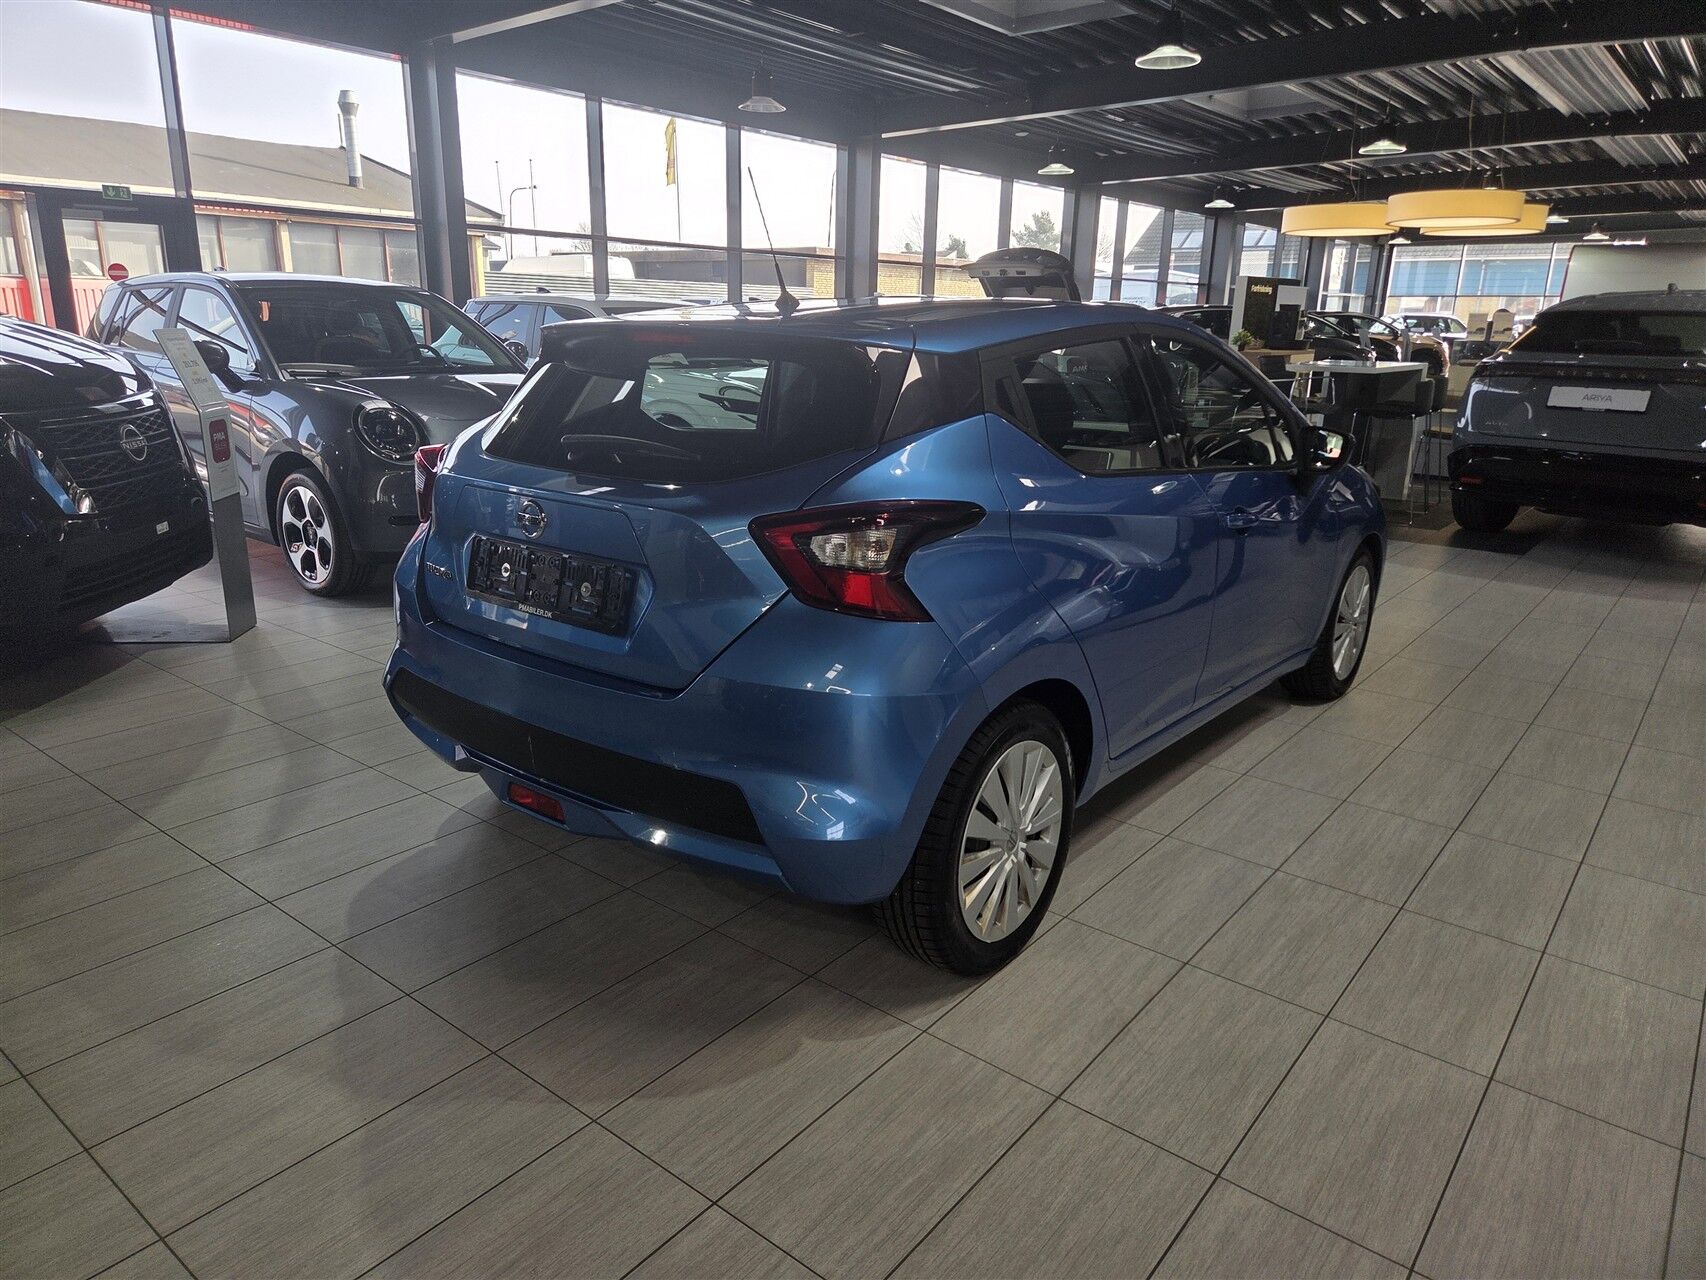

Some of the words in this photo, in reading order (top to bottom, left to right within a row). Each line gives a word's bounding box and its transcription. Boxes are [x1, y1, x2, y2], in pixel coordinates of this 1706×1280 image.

[1582, 394, 1613, 402] ARIYA
[122, 440, 146, 449] NISSA
[518, 603, 553, 618] PMABILER.DK
